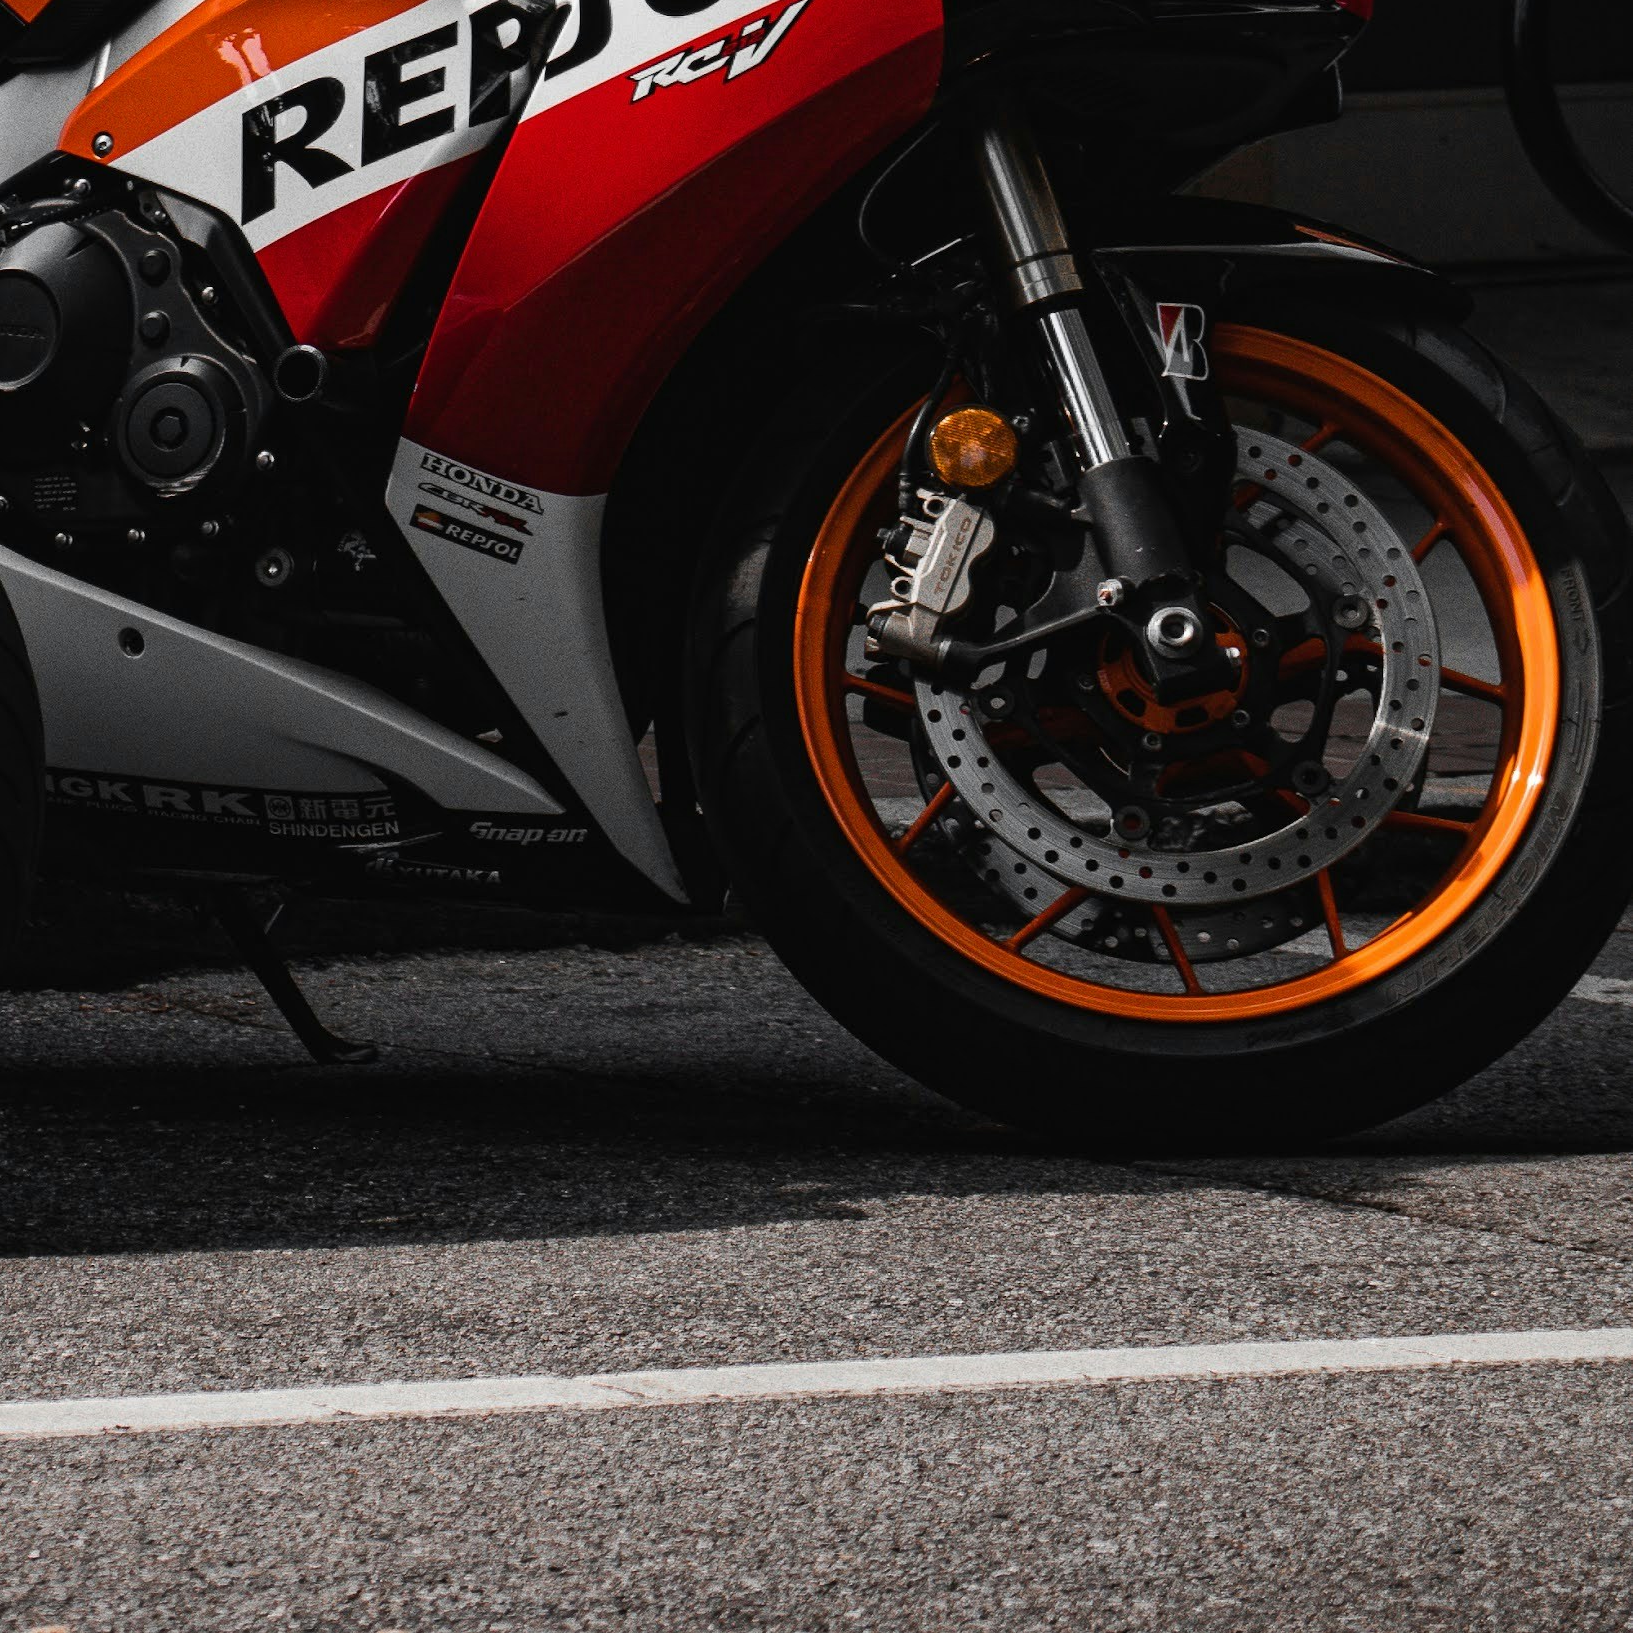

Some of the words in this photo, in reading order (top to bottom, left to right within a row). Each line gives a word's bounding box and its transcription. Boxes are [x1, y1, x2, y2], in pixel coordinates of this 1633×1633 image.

[420, 452, 545, 516] HONDA
[445, 523, 519, 560] REPSOL
[933, 517, 973, 594] TOKICO
[143, 784, 260, 817] RK
[269, 820, 399, 838] SHINDENGEN
